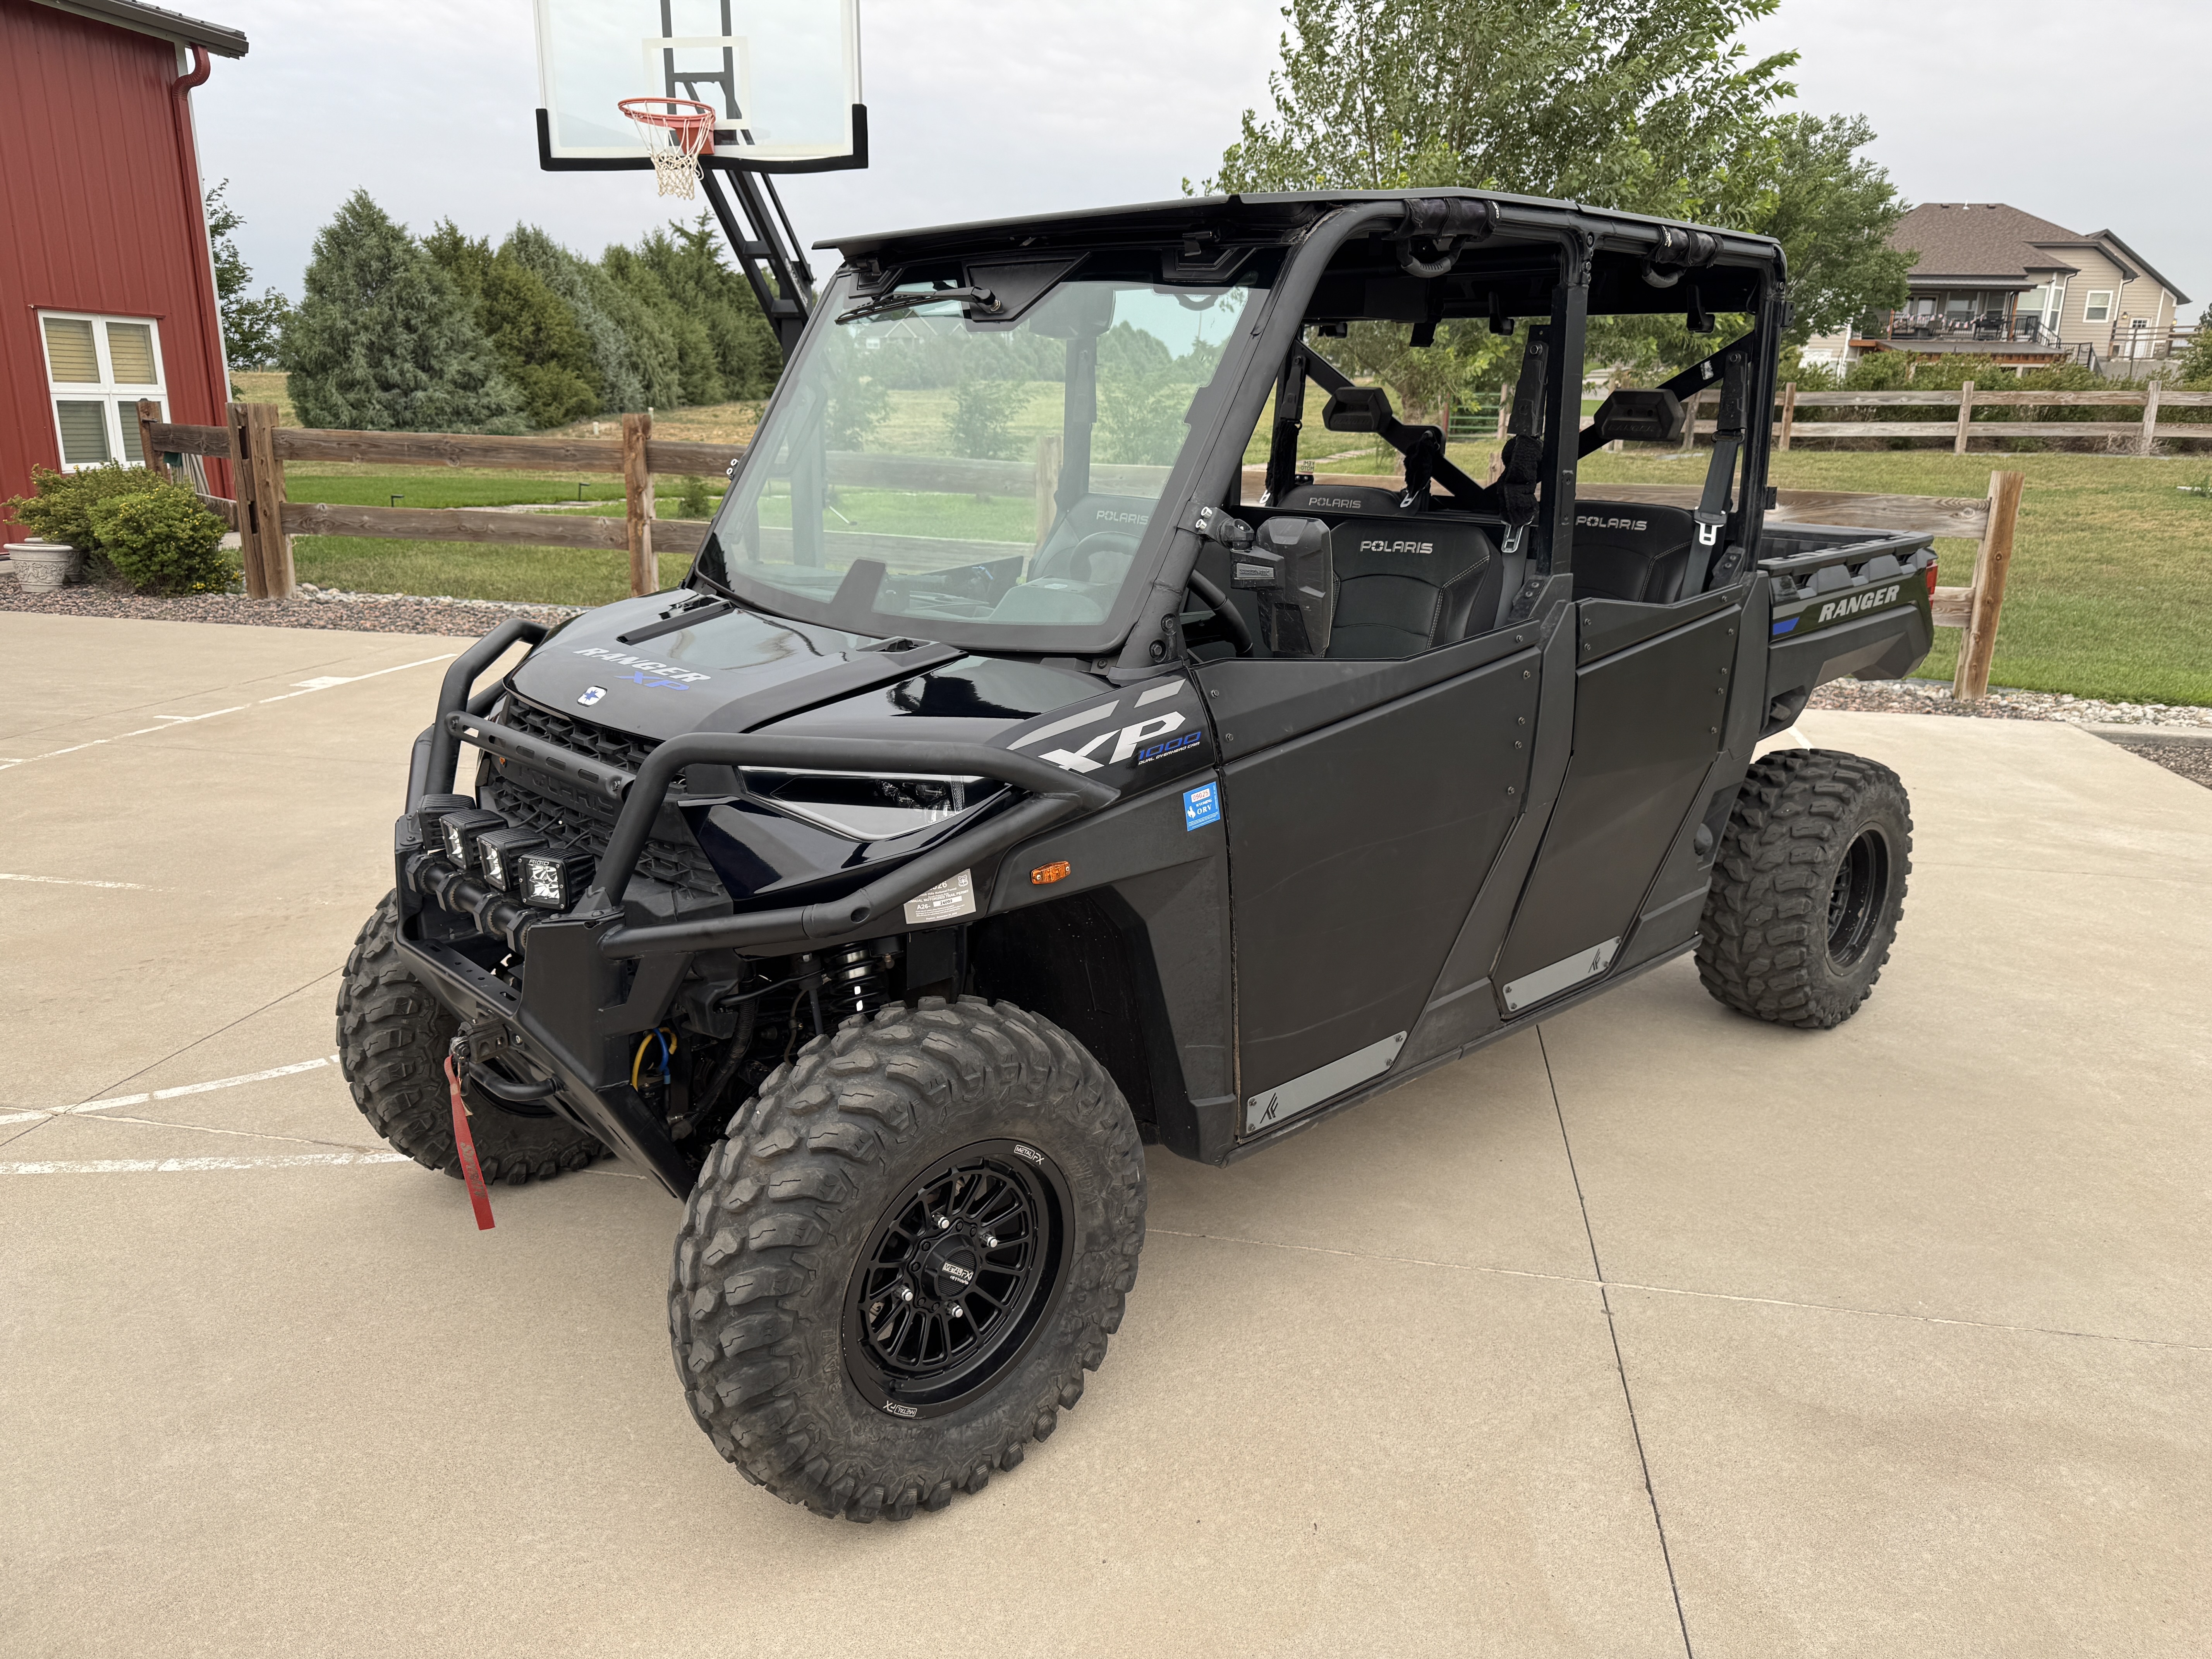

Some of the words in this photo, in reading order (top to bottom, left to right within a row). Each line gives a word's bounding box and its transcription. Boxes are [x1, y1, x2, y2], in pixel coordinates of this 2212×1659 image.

[1309, 497, 1361, 508] POLARIS
[1096, 510, 1149, 525] POLARIS
[1575, 516, 1647, 531] POLARIS
[1360, 541, 1433, 554] POLARIS
[1818, 585, 1900, 623] RANGER
[573, 648, 711, 682] RANGER
[613, 671, 689, 690] XP
[1038, 711, 1186, 773] XP
[1139, 732, 1201, 760] 1000
[1138, 757, 1155, 766] DUAL
[1156, 746, 1187, 759] OVERHEAD
[1193, 790, 1208, 800] 09025
[1197, 804, 1212, 815] ORV
